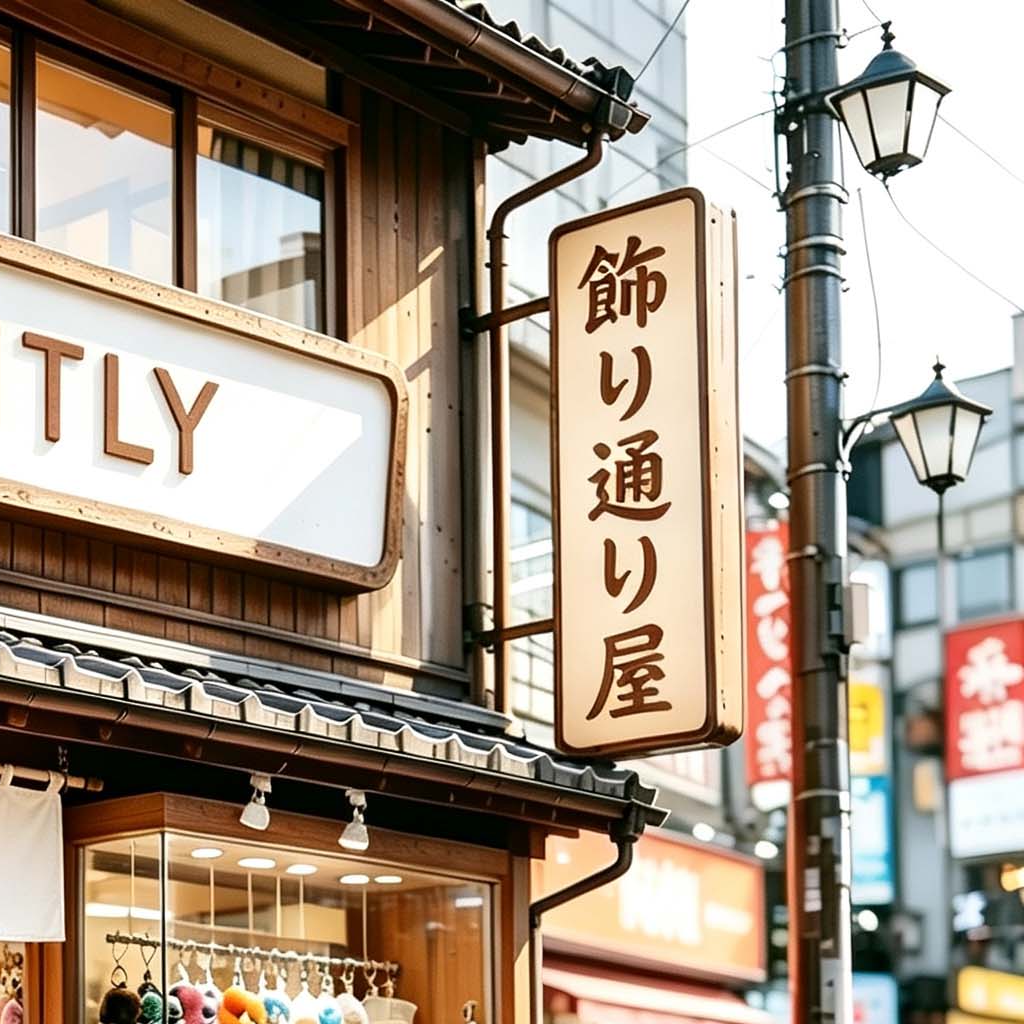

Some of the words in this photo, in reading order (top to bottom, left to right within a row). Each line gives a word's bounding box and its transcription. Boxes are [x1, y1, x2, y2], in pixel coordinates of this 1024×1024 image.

[577, 235, 673, 721] 飾り通り屋
